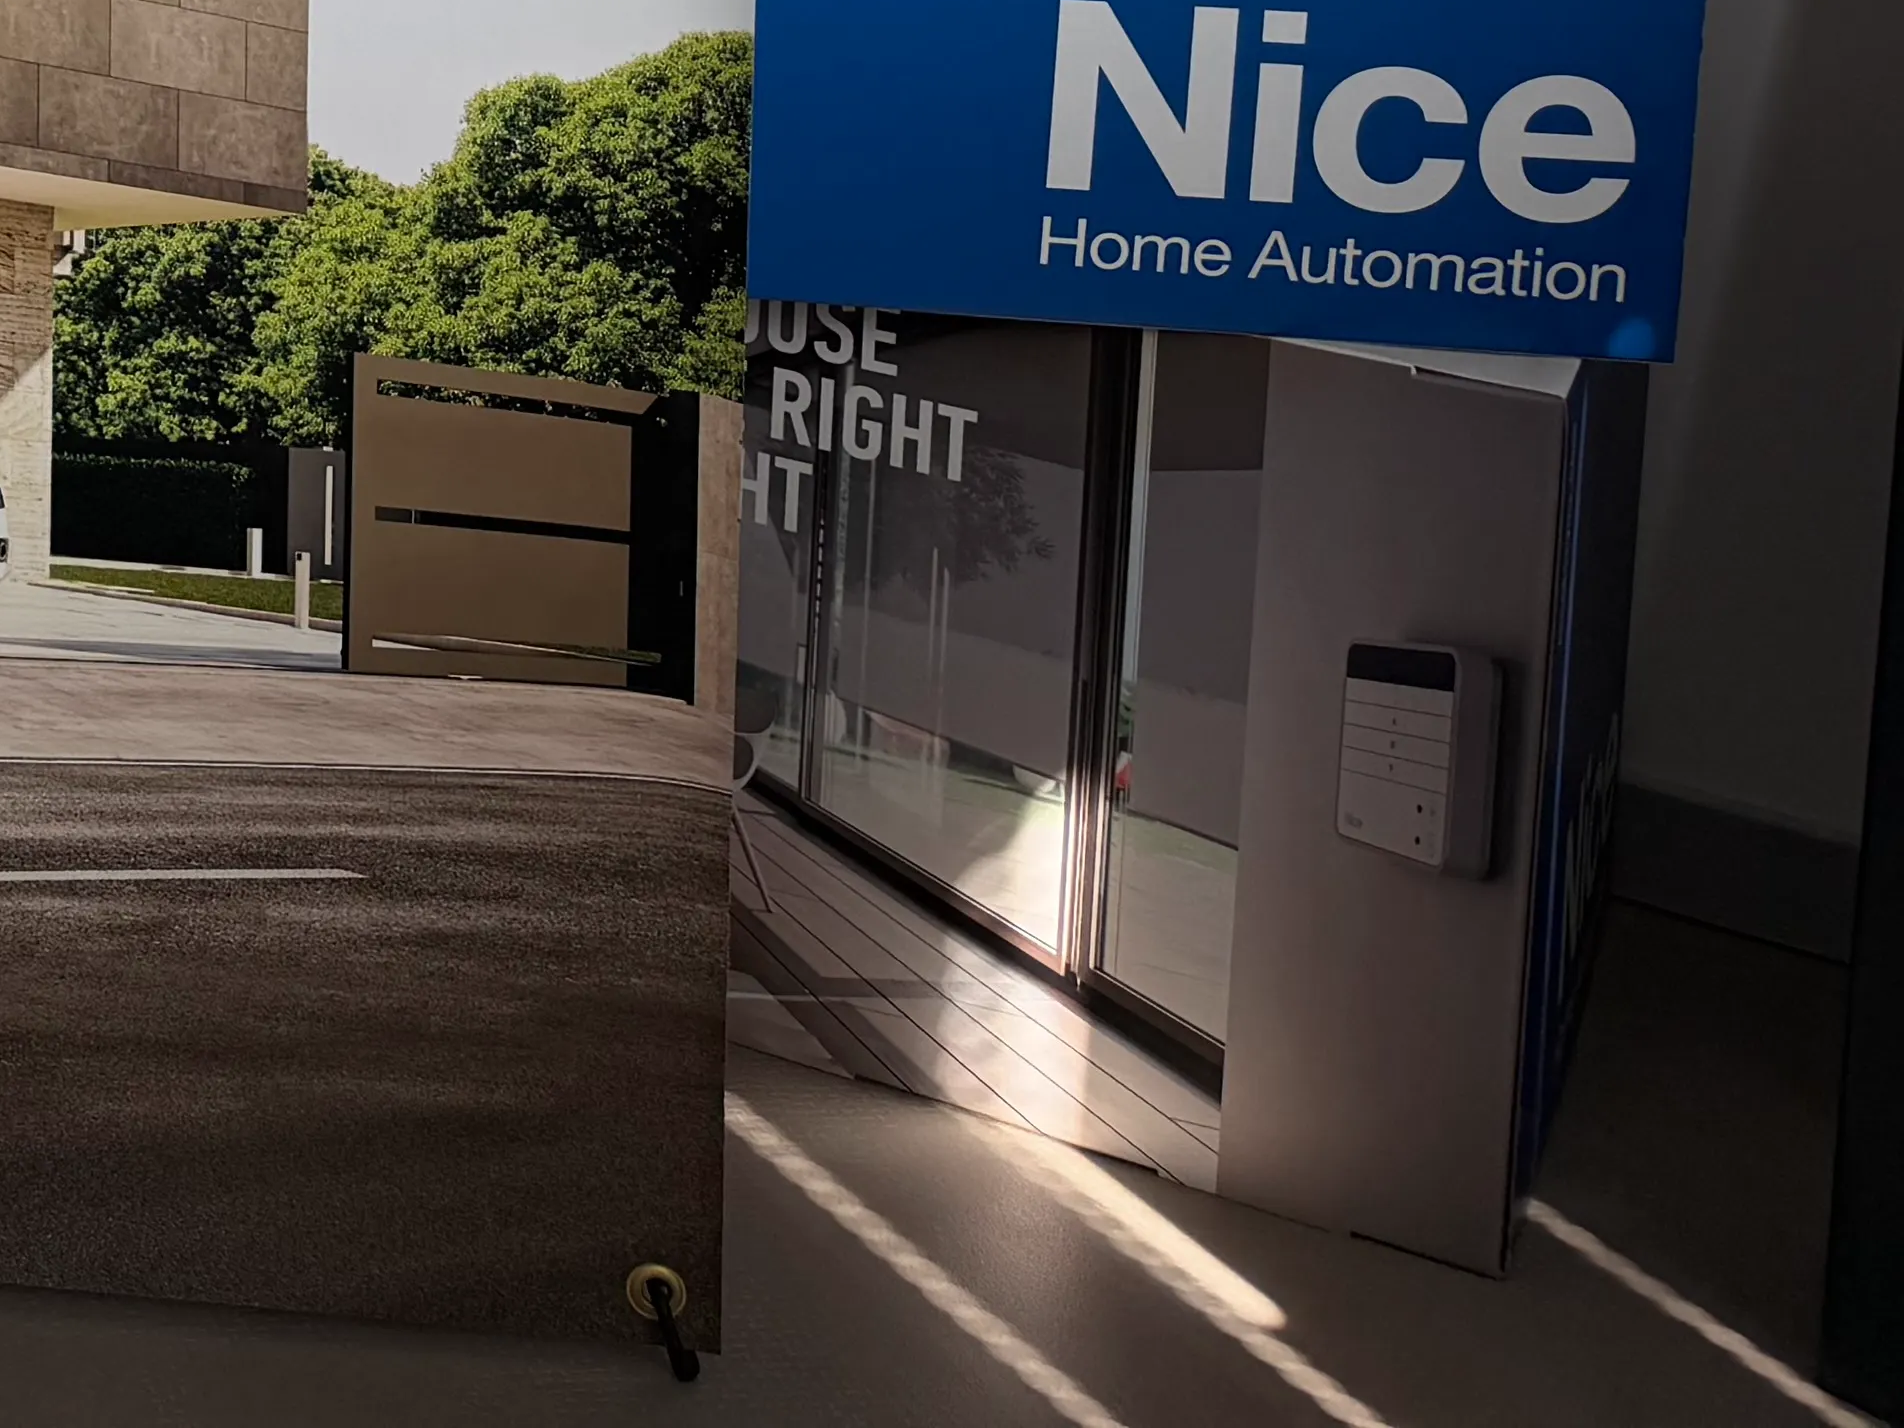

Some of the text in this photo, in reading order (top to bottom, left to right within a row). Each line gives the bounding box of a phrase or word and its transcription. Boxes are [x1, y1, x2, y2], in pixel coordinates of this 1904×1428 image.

[1039, 216, 1625, 302] Home Automation
[770, 366, 979, 483] RIGHT
